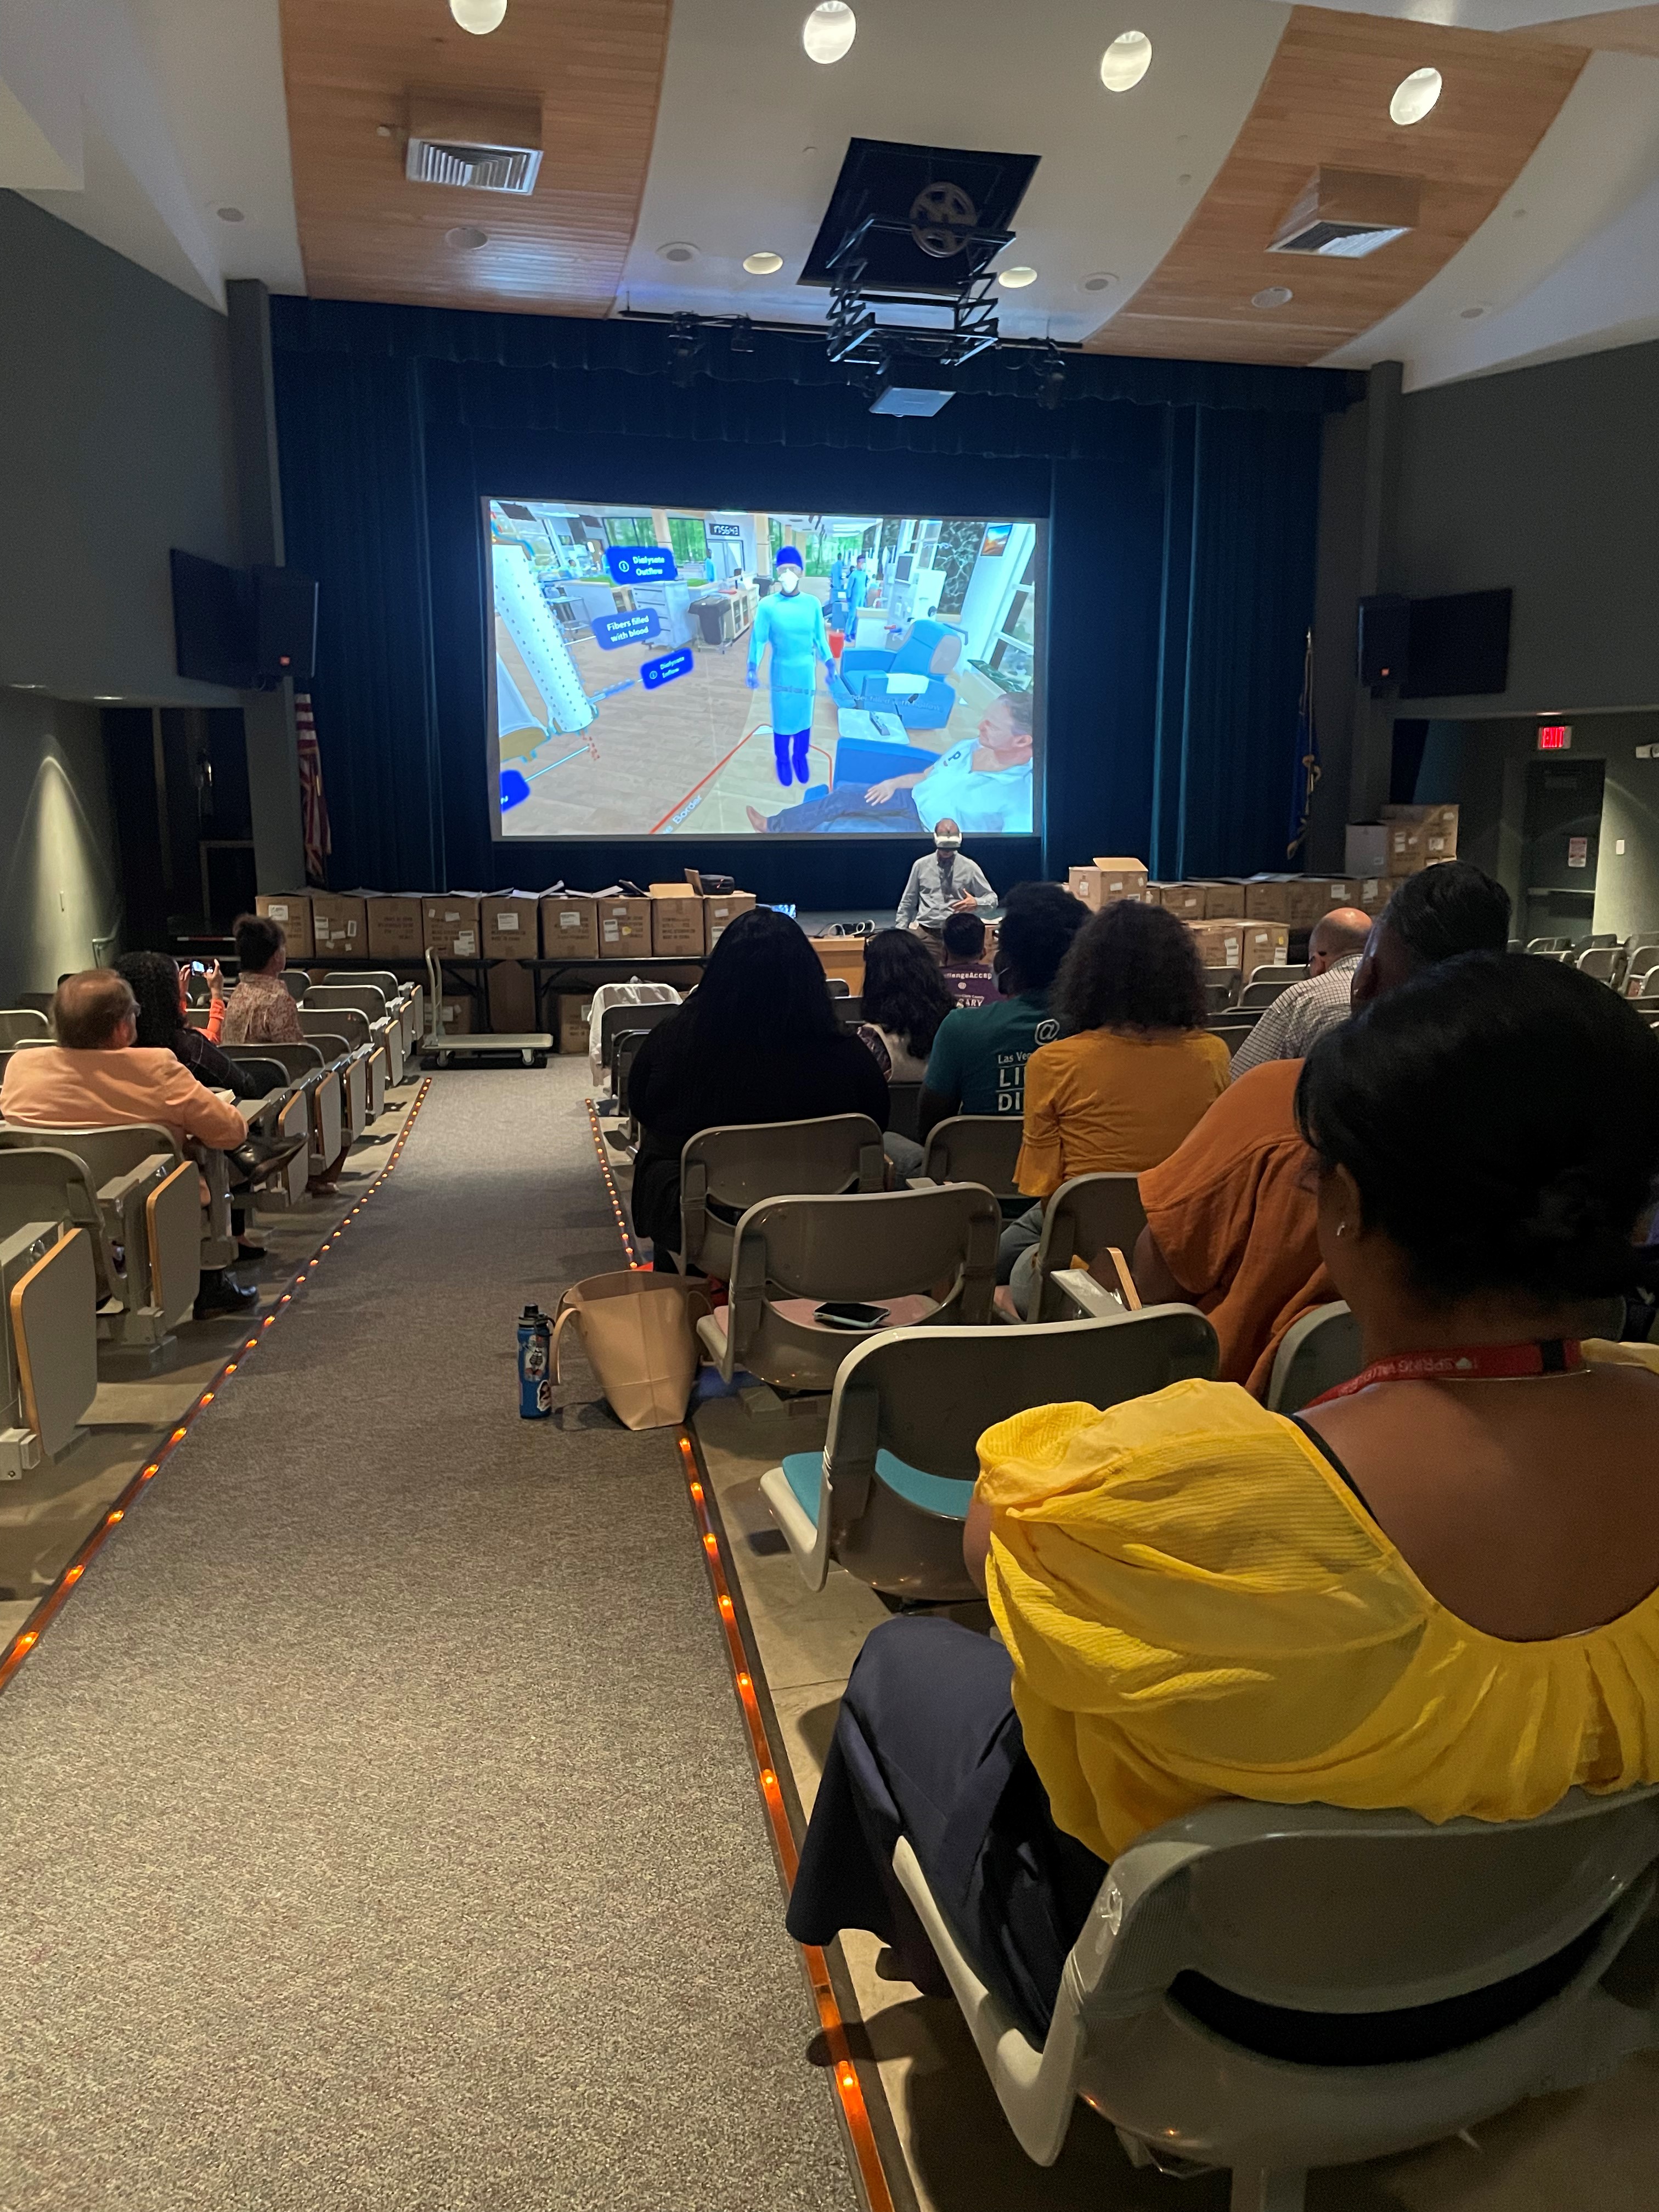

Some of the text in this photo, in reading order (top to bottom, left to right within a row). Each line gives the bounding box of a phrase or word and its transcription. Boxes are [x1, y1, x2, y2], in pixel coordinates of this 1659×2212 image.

[607, 615, 650, 631] Fibers filled
[610, 626, 649, 642] with blood
[1542, 726, 1565, 748] EXIT
[673, 795, 702, 824] Border
[998, 1054, 1014, 1064] Las
[1000, 1066, 1025, 1087] LI
[1398, 1358, 1454, 1372] SPRING
